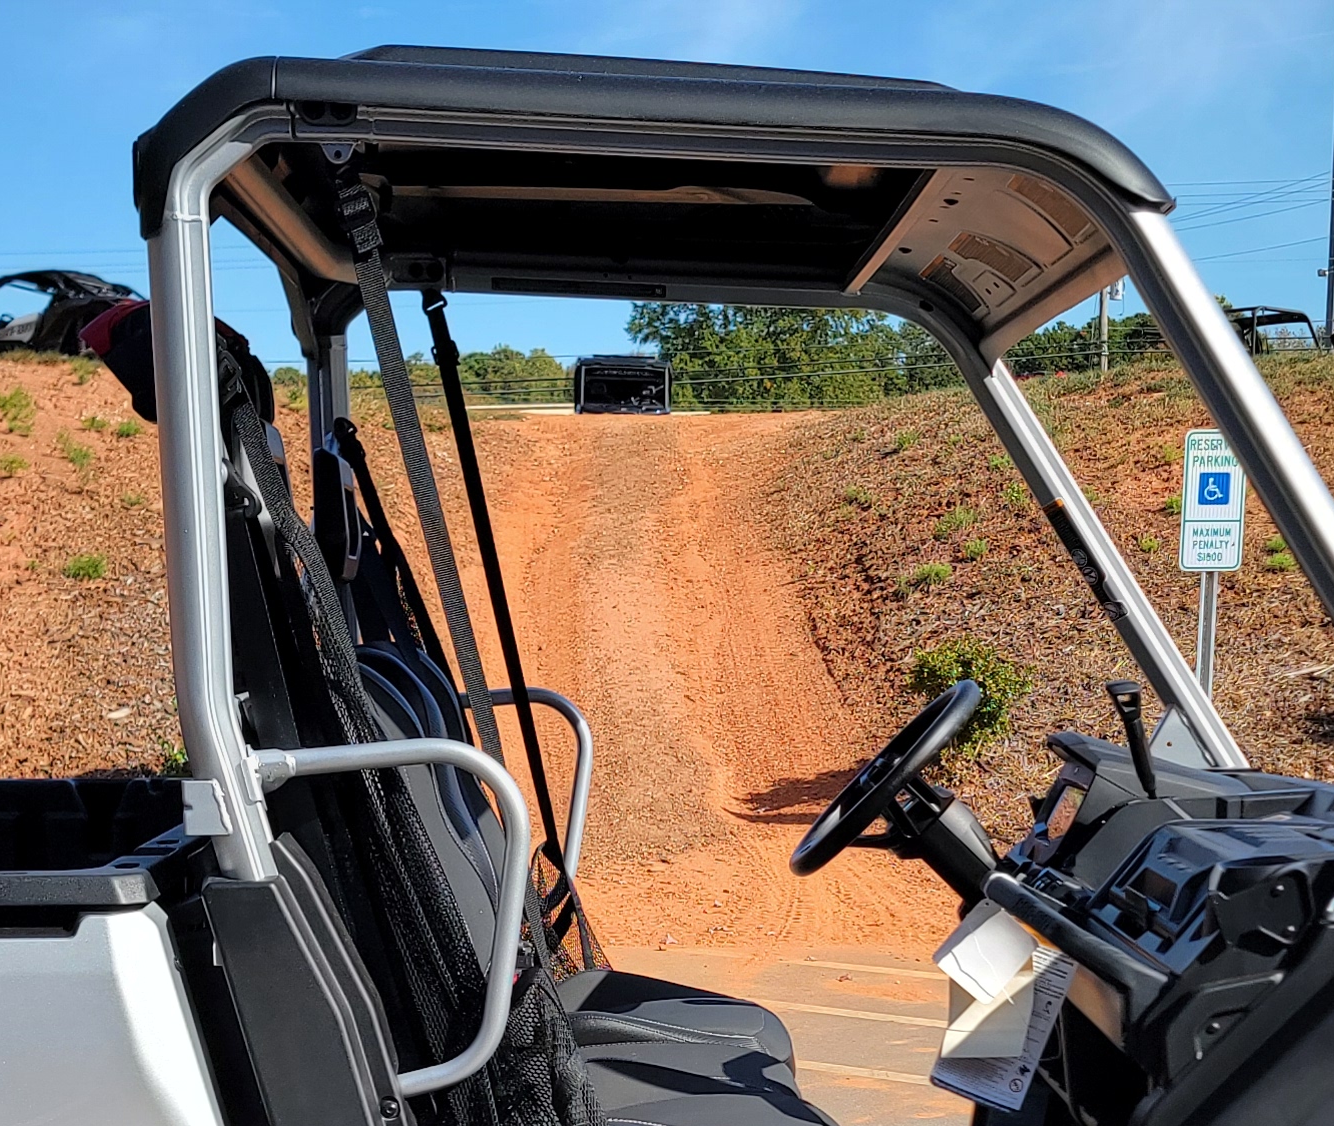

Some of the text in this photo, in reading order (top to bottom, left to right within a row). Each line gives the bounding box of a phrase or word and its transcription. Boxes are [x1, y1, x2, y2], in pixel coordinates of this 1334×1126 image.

[1192, 455, 1238, 468] PARKING
[1192, 527, 1231, 537] MAXIMUM
[1192, 540, 1229, 550] PENALTY
